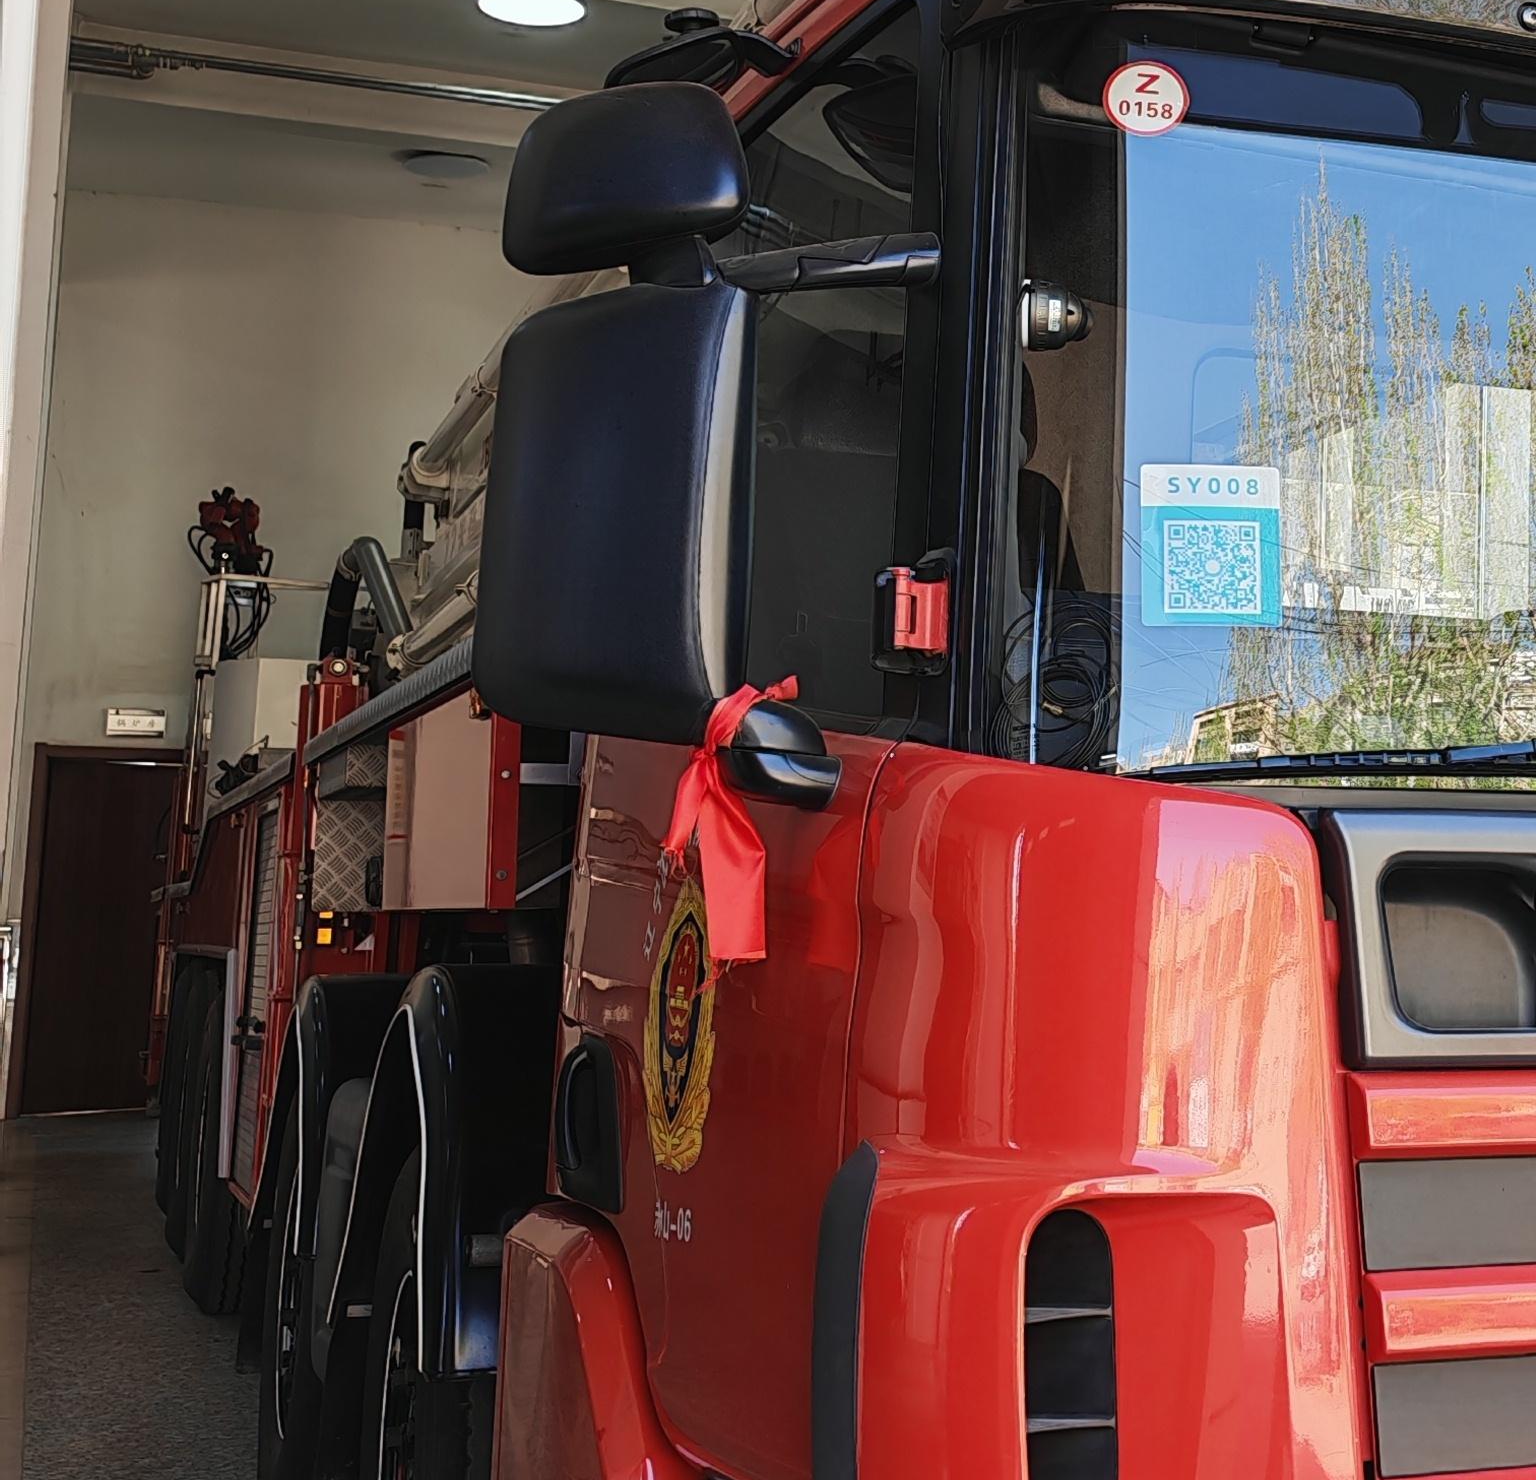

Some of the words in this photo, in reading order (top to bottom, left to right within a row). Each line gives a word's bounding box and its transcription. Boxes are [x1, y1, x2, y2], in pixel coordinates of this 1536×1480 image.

[1135, 73, 1160, 95] Z
[1118, 100, 1173, 120] 0158
[1167, 477, 1259, 495] SY008
